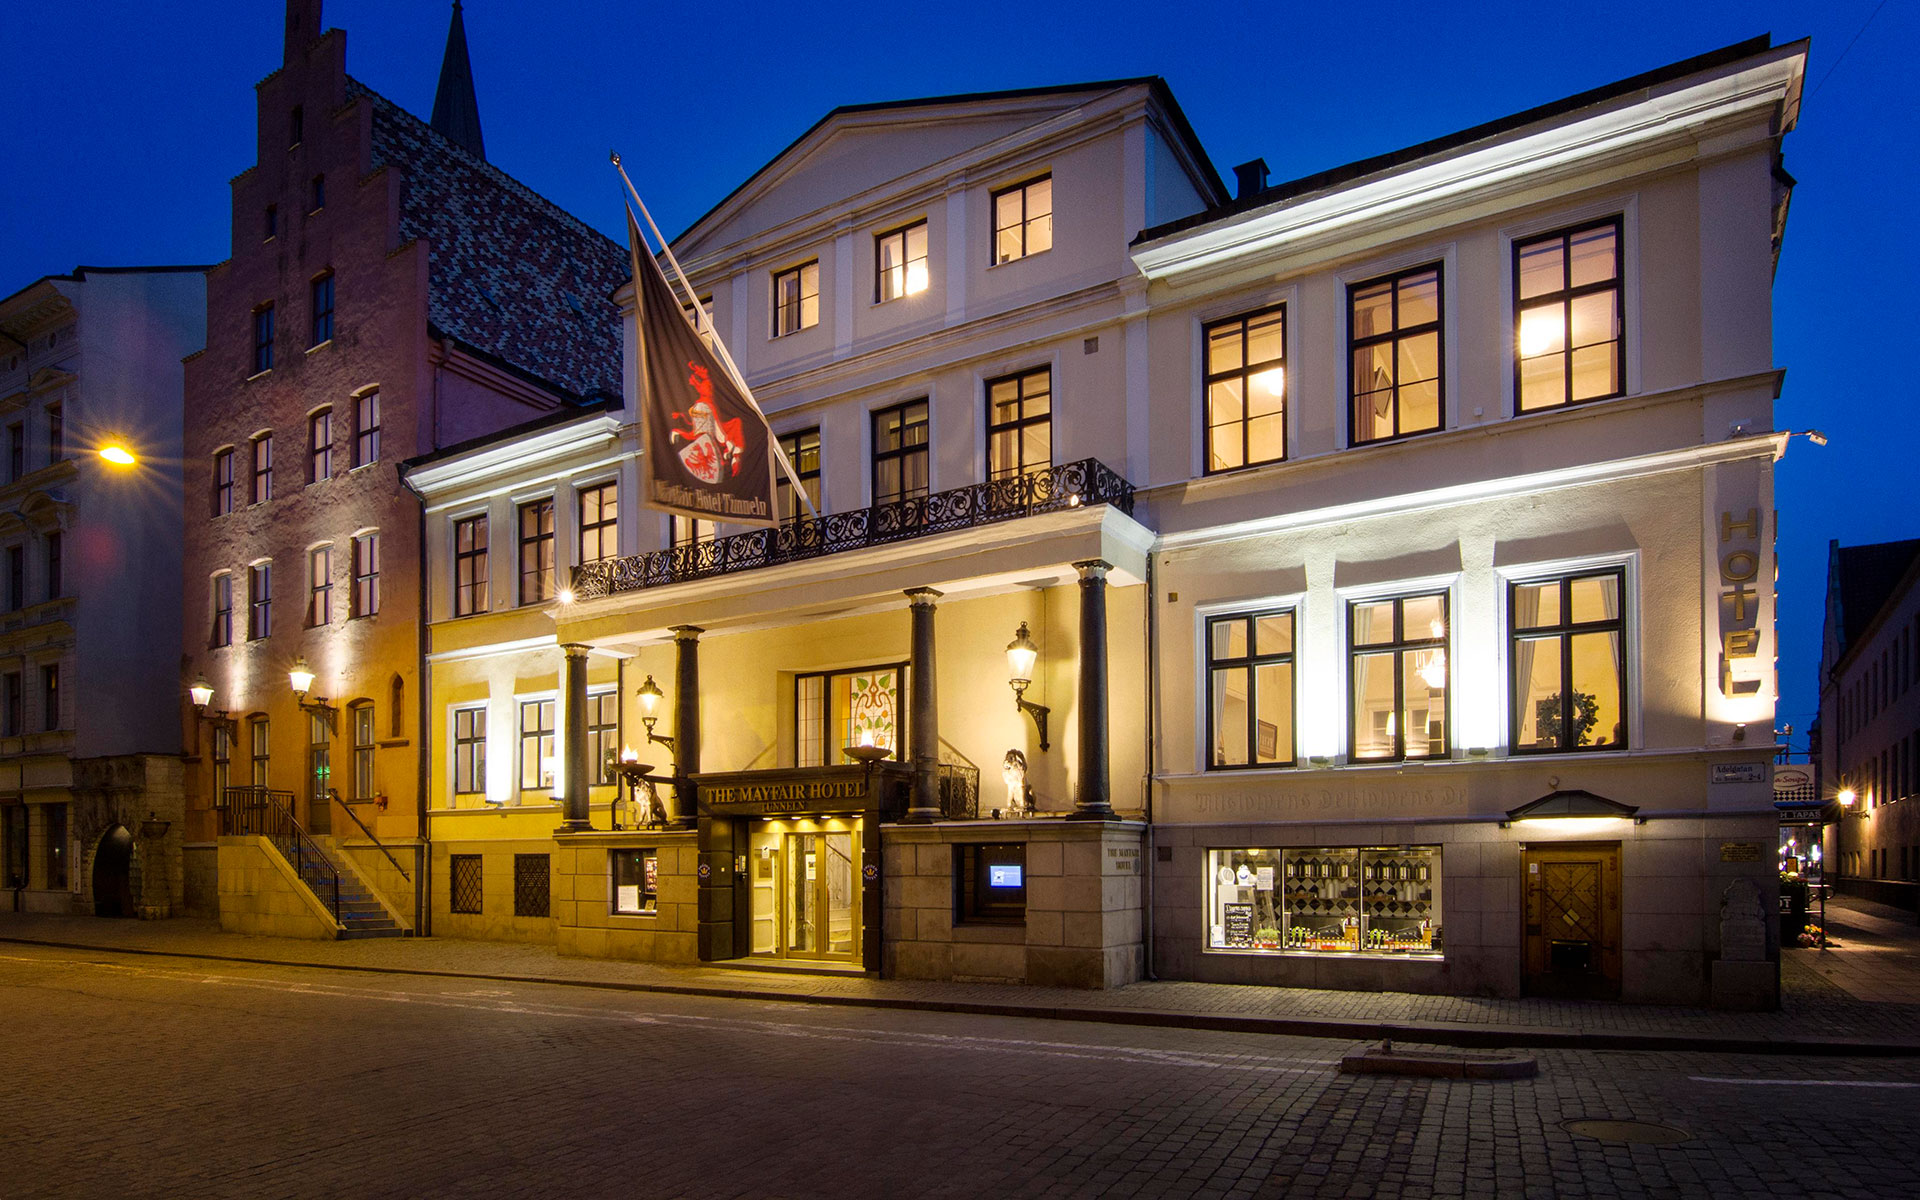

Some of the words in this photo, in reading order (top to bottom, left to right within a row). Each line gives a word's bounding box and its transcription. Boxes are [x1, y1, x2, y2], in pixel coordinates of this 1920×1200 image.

[696, 489, 721, 513] Hotel
[722, 493, 767, 516] Tunneln
[1721, 508, 1758, 699] HOTEL
[705, 788, 735, 803] THE
[739, 784, 806, 802] MAYFAIR
[809, 782, 865, 799] HOTEL
[761, 801, 805, 812] TUNNELN
